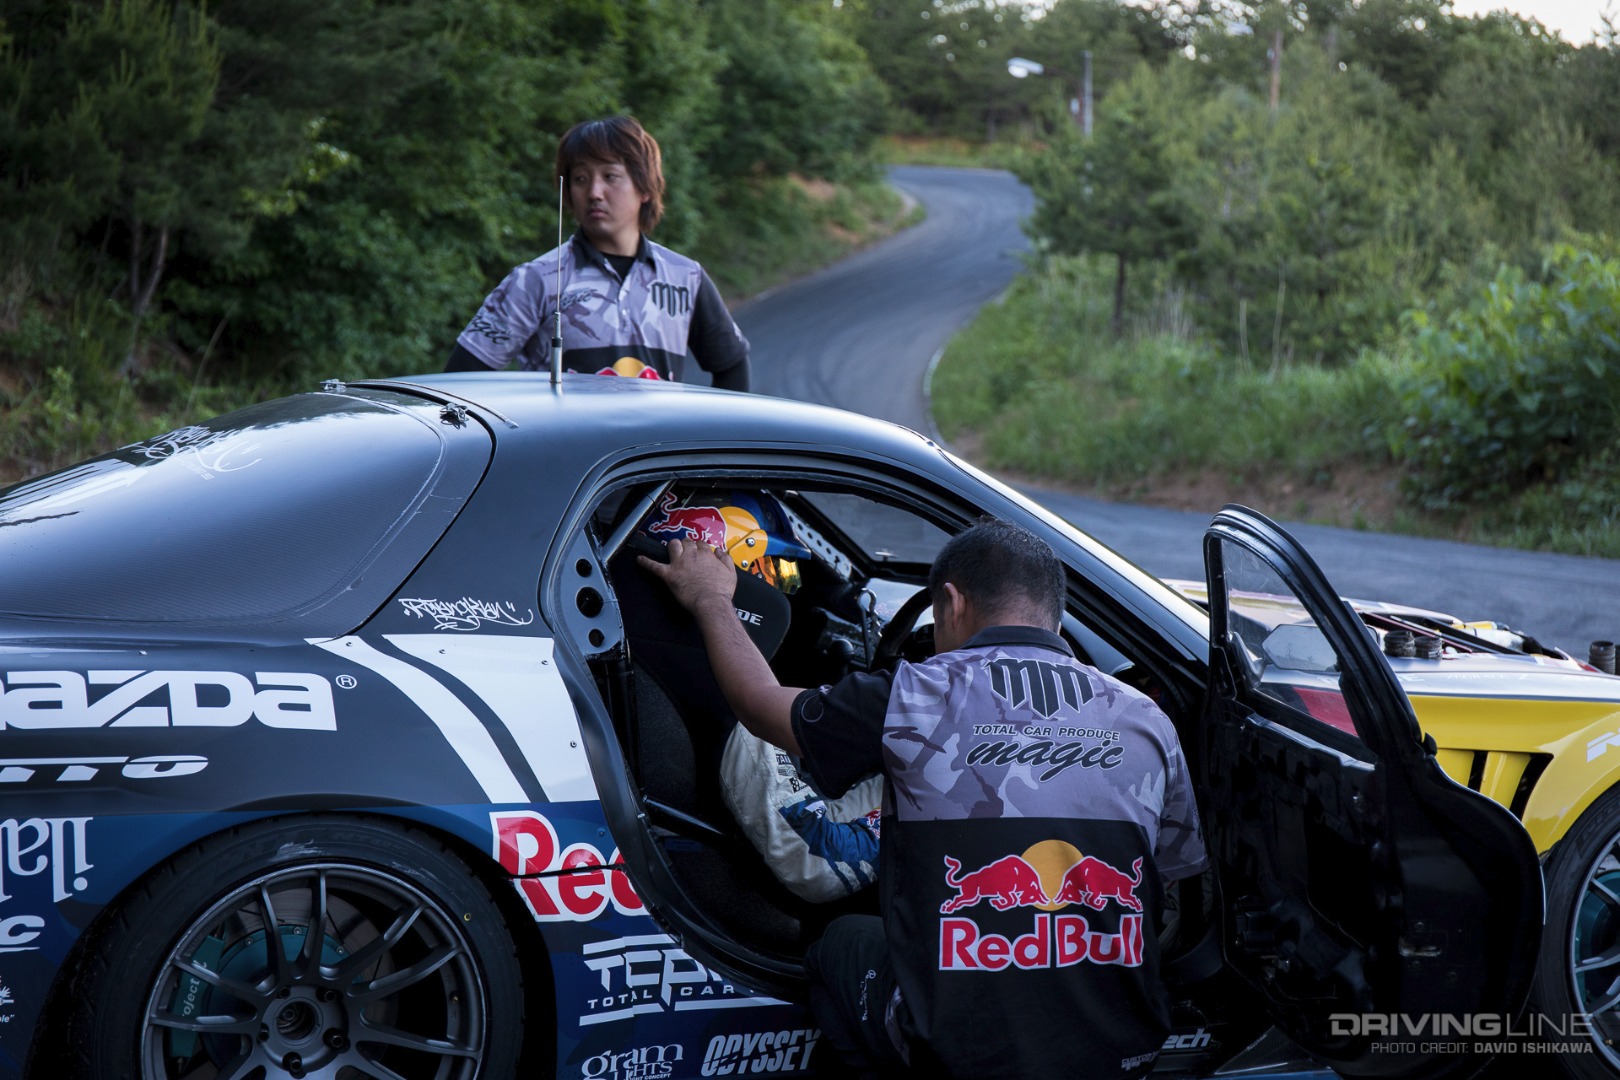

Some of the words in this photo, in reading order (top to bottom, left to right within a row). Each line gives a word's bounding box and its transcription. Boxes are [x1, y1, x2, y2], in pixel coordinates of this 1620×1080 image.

[735, 608, 763, 626] DE
[0, 670, 338, 731] azda
[973, 725, 1017, 736] TOTAL
[1024, 726, 1051, 737] CAR
[1058, 727, 1120, 742] PRODUCE
[966, 739, 1124, 783] magic
[938, 912, 1051, 972] Red
[1055, 913, 1145, 968] Bull
[182, 977, 200, 1017] oject
[588, 988, 653, 1009] TOTAL
[680, 985, 736, 997] CAR
[700, 1029, 821, 1077] ODYSSEY
